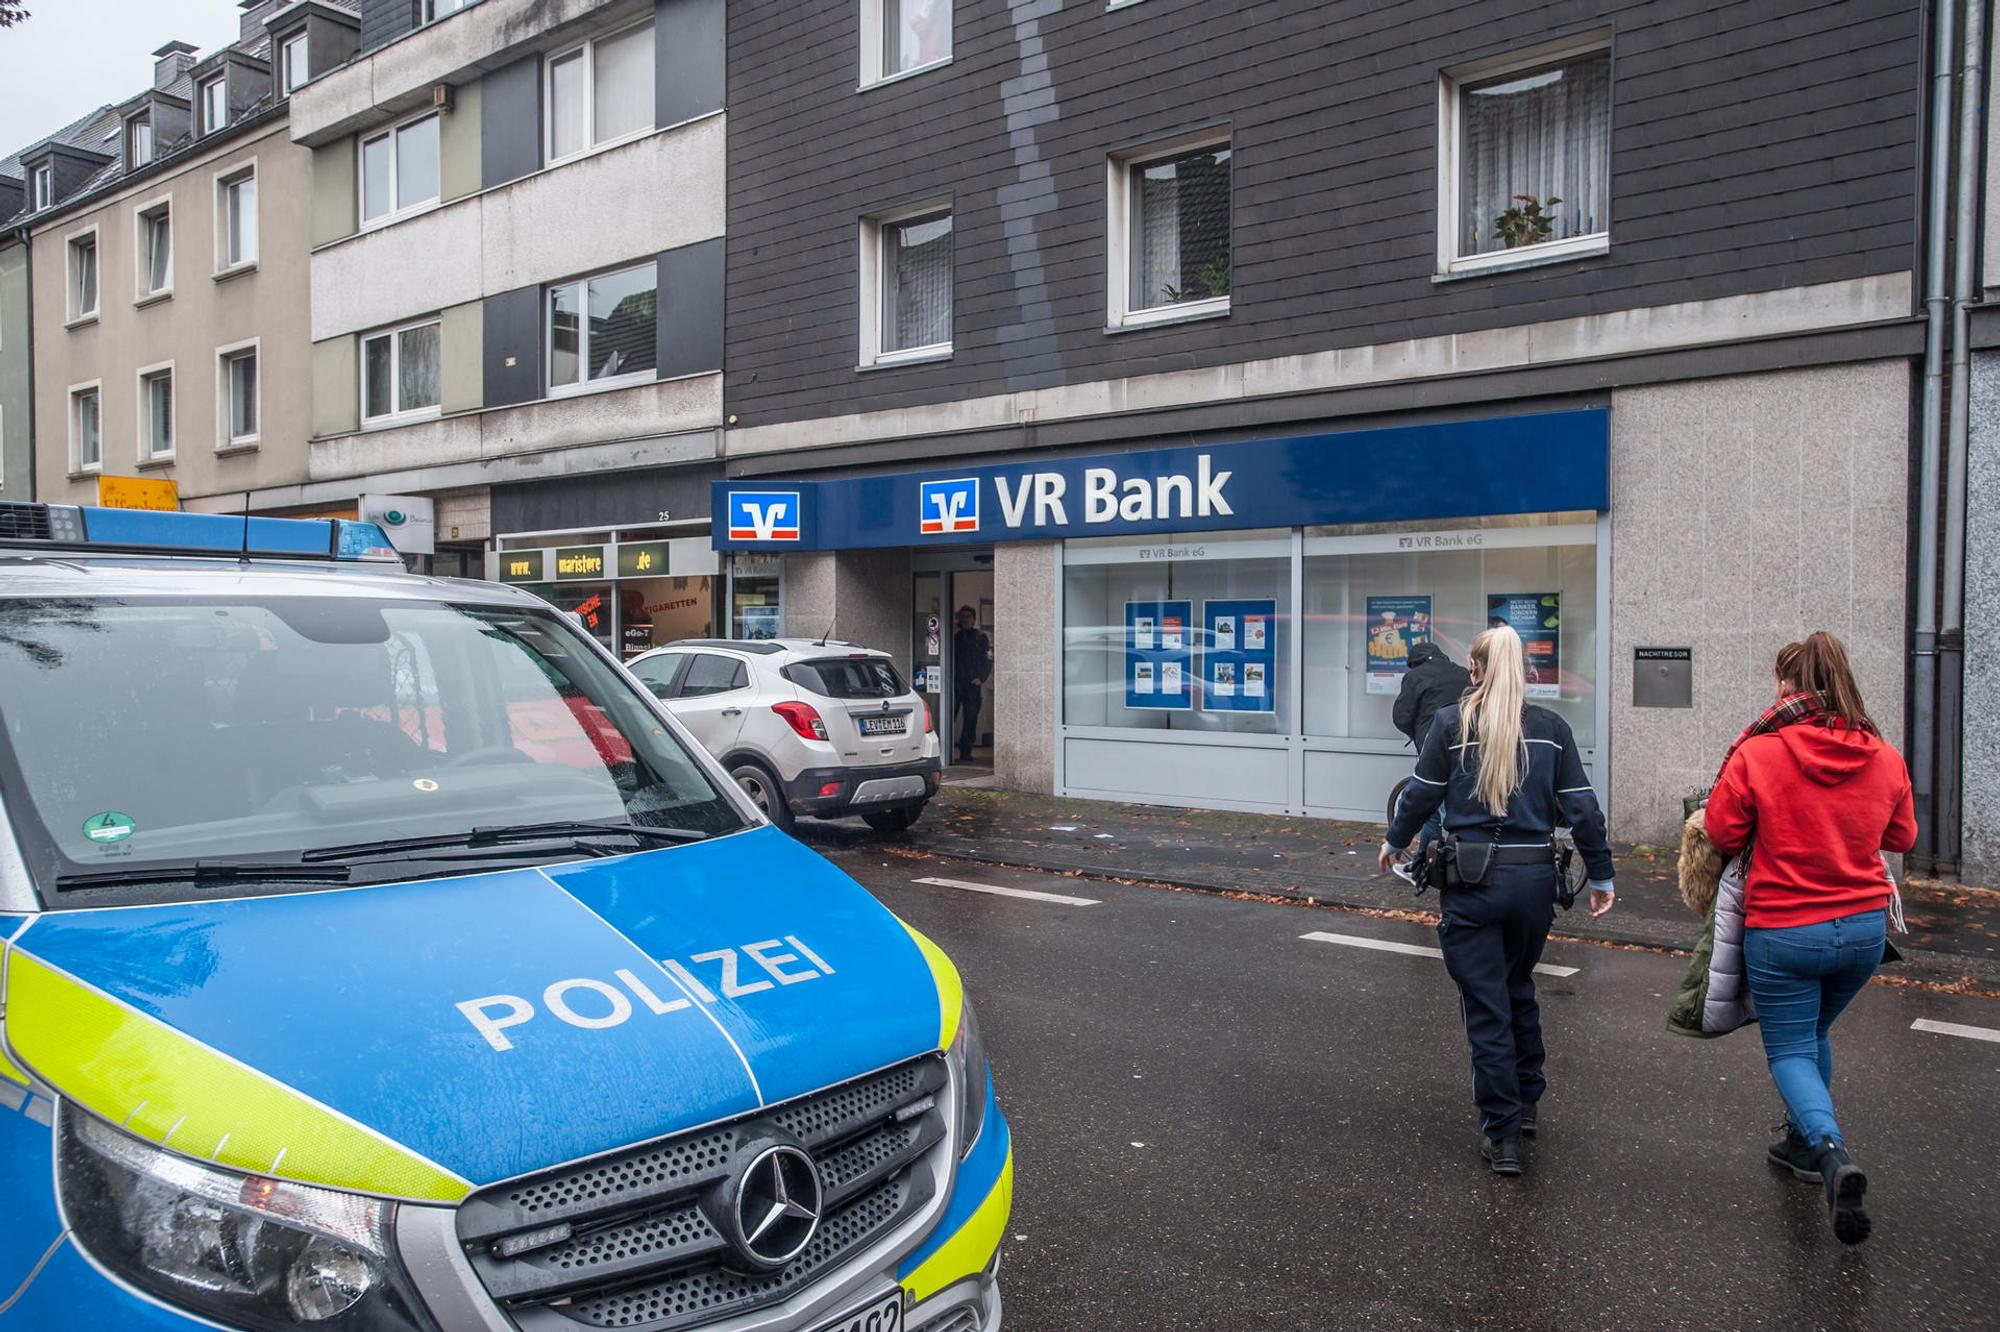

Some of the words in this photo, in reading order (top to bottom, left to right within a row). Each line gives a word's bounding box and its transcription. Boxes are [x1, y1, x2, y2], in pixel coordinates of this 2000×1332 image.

[994, 472, 1069, 528] VR
[1084, 454, 1234, 523] Bank
[658, 510, 670, 521] 25
[1416, 536, 1432, 547] VR
[1434, 534, 1463, 546] Bank
[1466, 534, 1482, 545] eG
[1152, 548, 1166, 559] VR
[1167, 547, 1191, 558] Bank
[510, 561, 531, 576] www.
[558, 554, 602, 574] maristore
[636, 551, 651, 571] .de
[102, 813, 116, 827] 4
[455, 935, 836, 1052] POLIZEI
